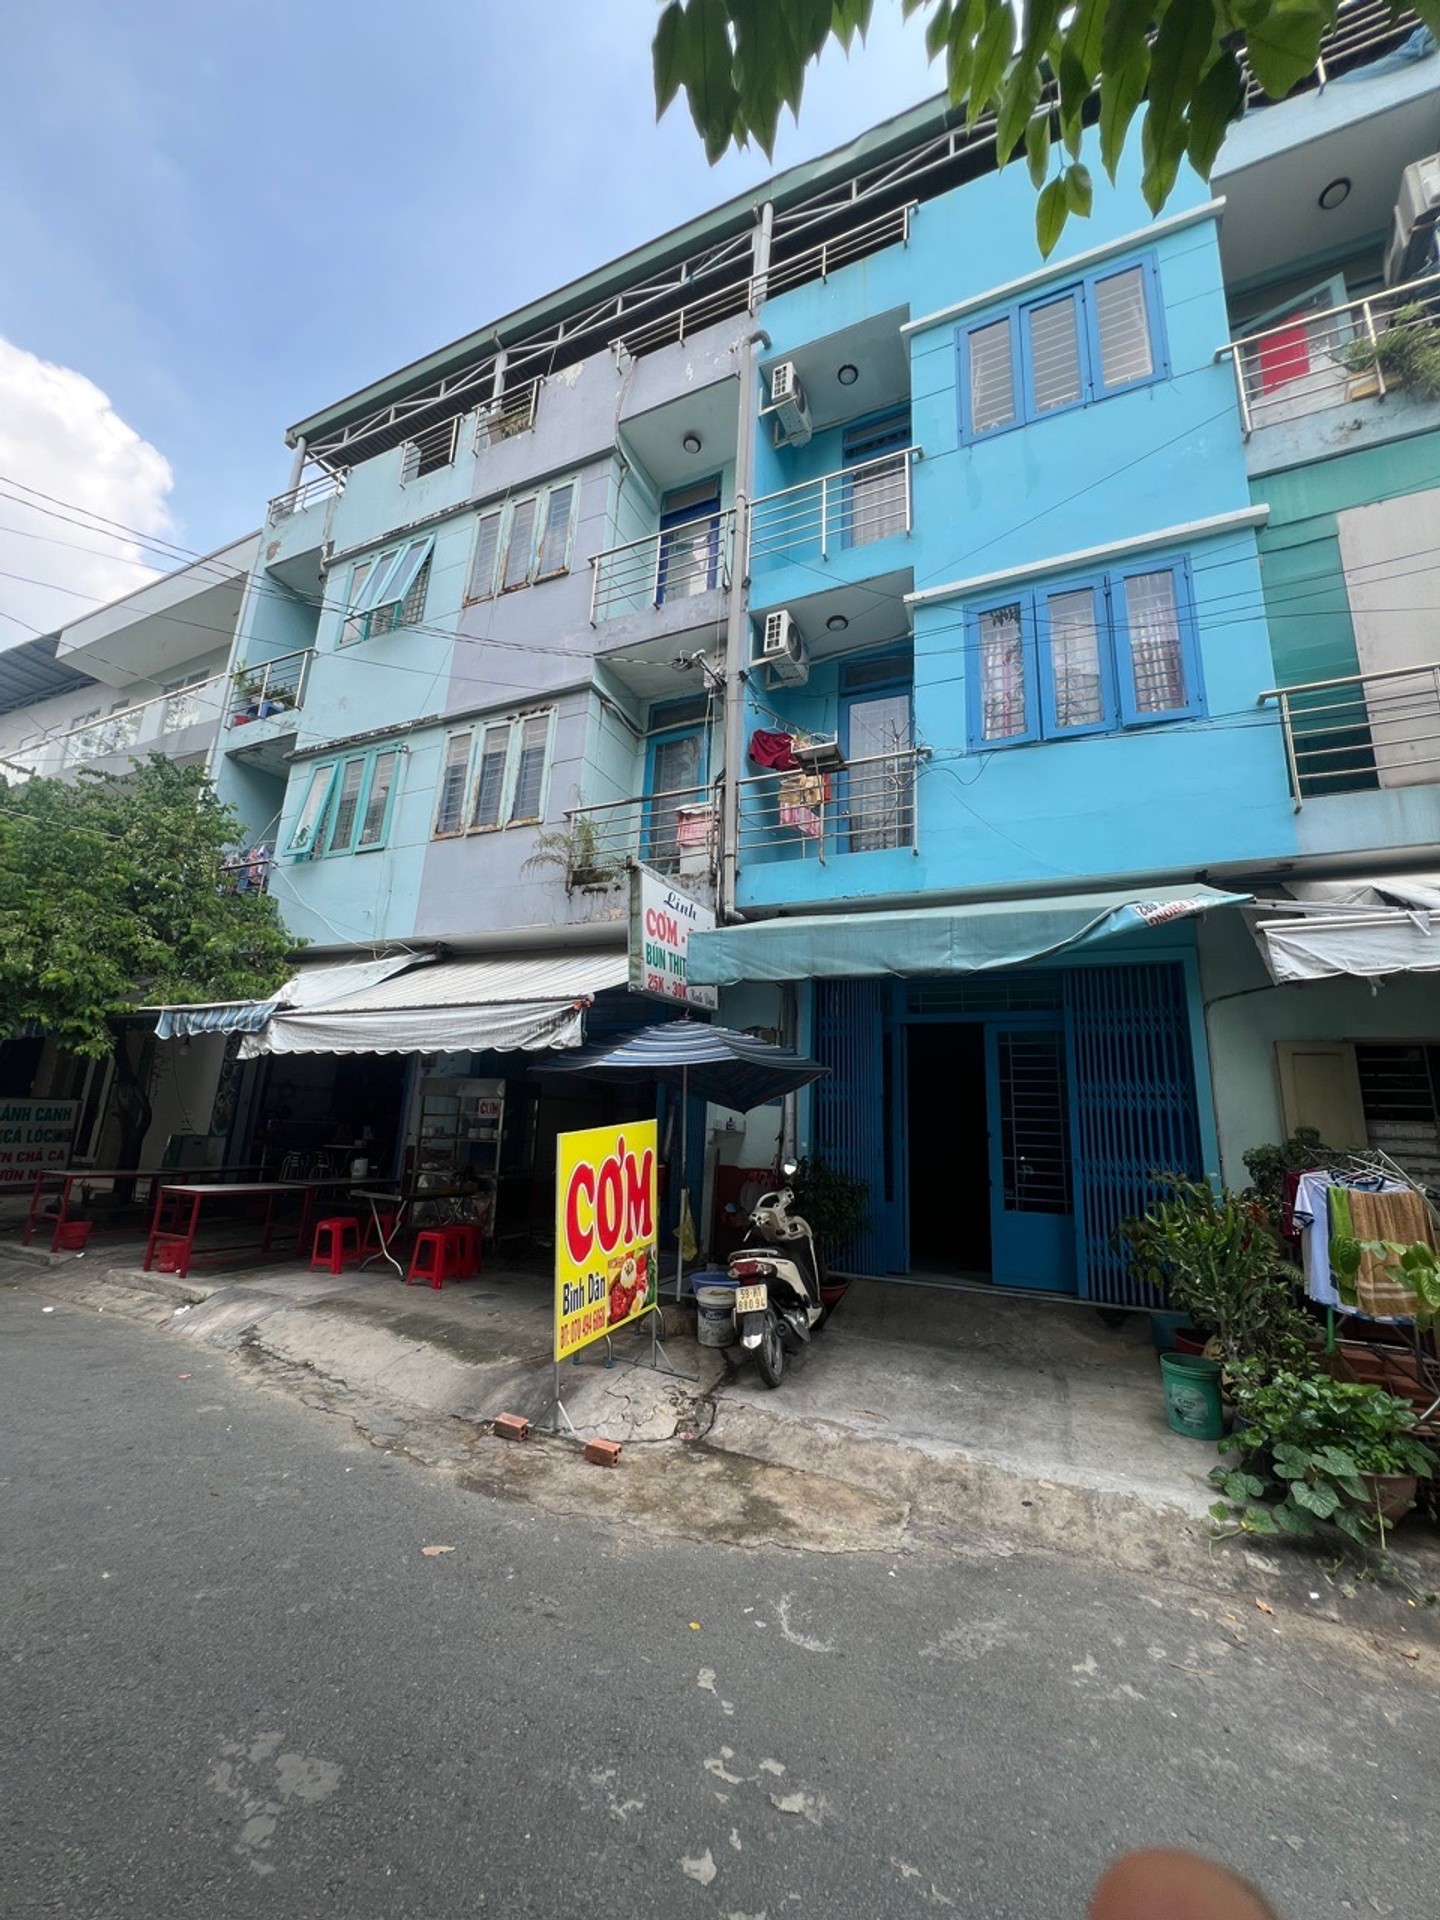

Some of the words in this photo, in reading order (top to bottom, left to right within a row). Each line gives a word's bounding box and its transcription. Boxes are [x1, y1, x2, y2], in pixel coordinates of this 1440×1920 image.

[663, 890, 698, 921] Linh
[646, 908, 678, 947] CƠM
[646, 942, 666, 970] BÚN
[648, 973, 665, 992] 25K
[0, 1103, 32, 1121] ÁNH
[35, 1107, 72, 1121] CANH
[567, 1135, 654, 1265] CƠM
[563, 1277, 584, 1316] Bình
[588, 1272, 606, 1304] Dân
